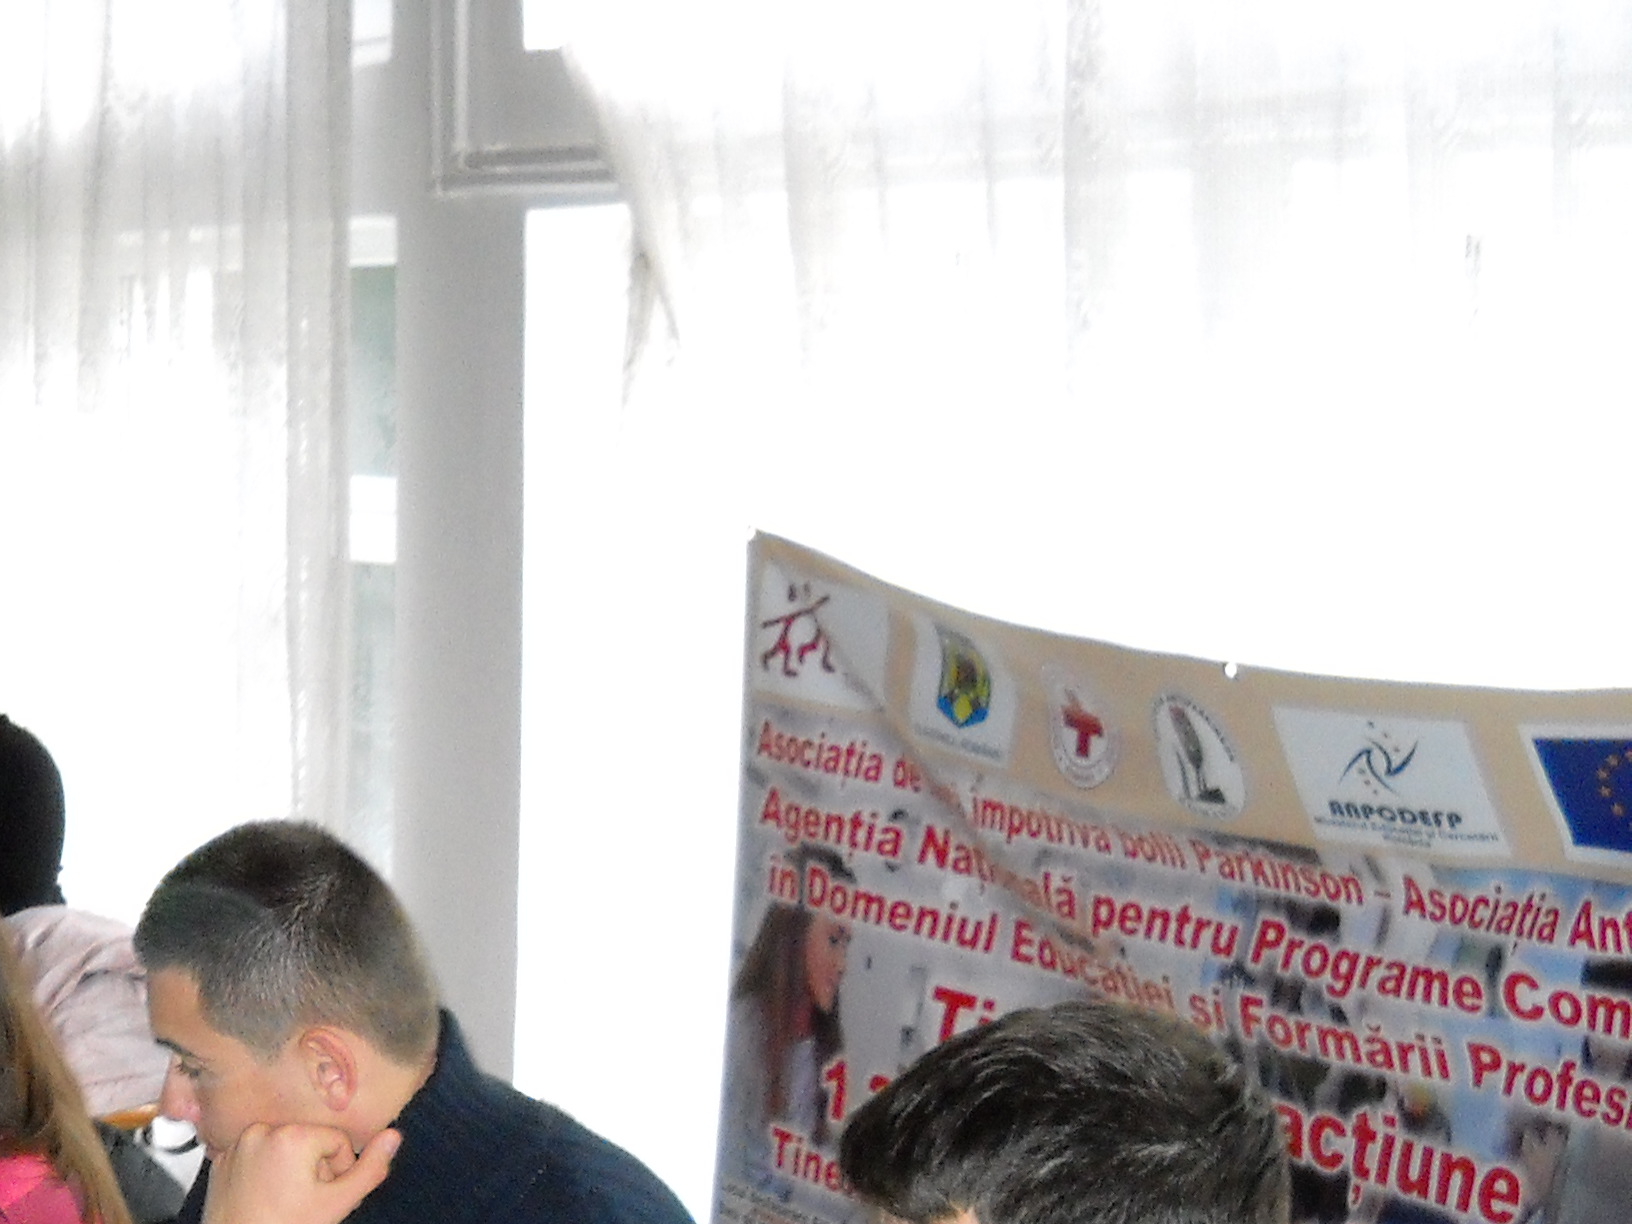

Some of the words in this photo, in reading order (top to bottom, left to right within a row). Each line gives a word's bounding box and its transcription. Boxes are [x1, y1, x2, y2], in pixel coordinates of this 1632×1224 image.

[807, 864, 1000, 954] Domeniul
[1238, 993, 1450, 1082] Formării
[1091, 894, 1239, 959] pentru
[1249, 918, 1485, 1014] Programe
[1502, 971, 1632, 1040] Com
[771, 1126, 855, 1194] Tine
